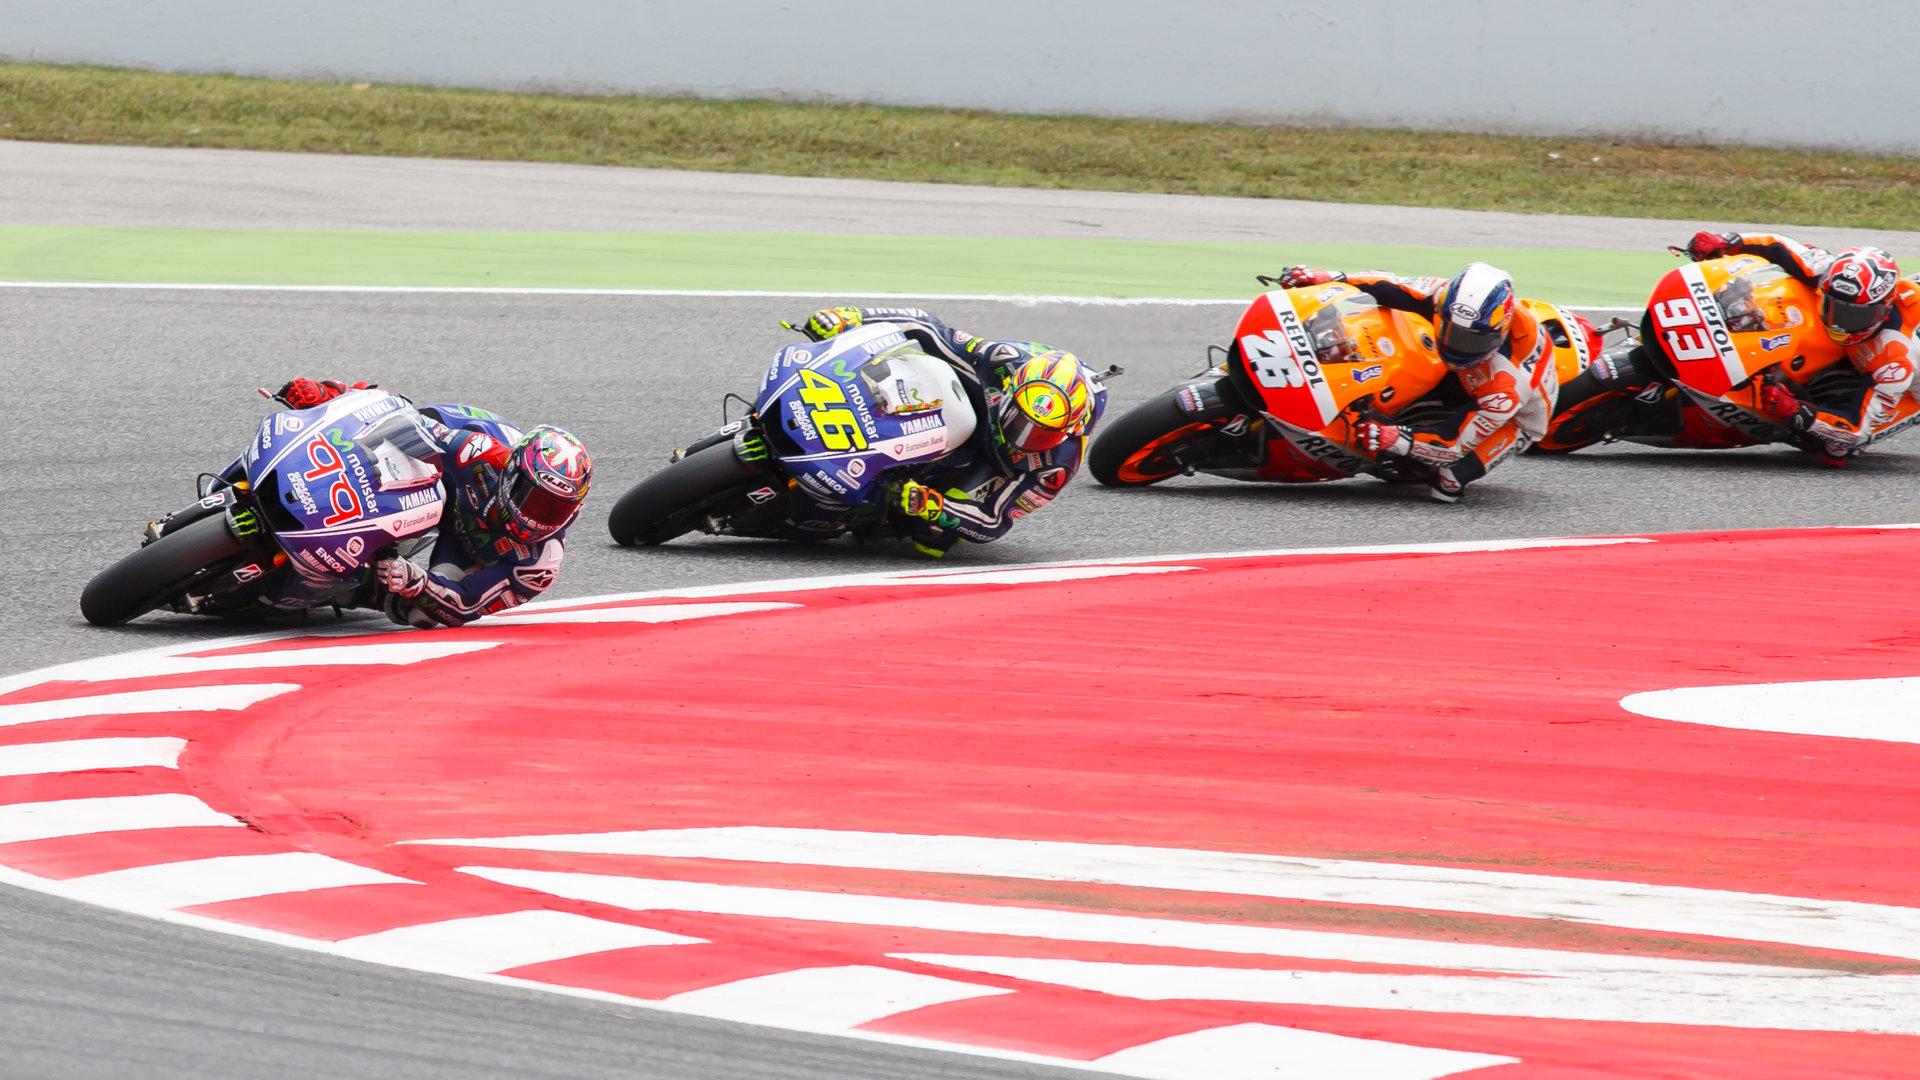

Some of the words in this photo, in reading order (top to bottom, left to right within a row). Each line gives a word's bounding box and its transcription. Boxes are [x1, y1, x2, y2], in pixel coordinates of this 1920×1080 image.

[1456, 304, 1478, 320] Arai
[1654, 298, 1717, 361] 93
[1691, 281, 1734, 357] REPSOL
[1241, 329, 1306, 388] 26
[1280, 310, 1324, 389] REPSOL
[799, 368, 868, 451] 46
[846, 383, 879, 439] movistar
[900, 414, 942, 436] YAMAHA
[262, 418, 272, 450] ENEOS
[303, 431, 364, 528] 99
[346, 453, 379, 514] movistar
[399, 488, 438, 510] YAMAHA
[541, 473, 572, 493] HJC
[816, 470, 848, 494] ENEOS
[403, 515, 427, 528] Eurasian
[426, 510, 438, 520] Bank
[315, 547, 346, 573] ENEOS
